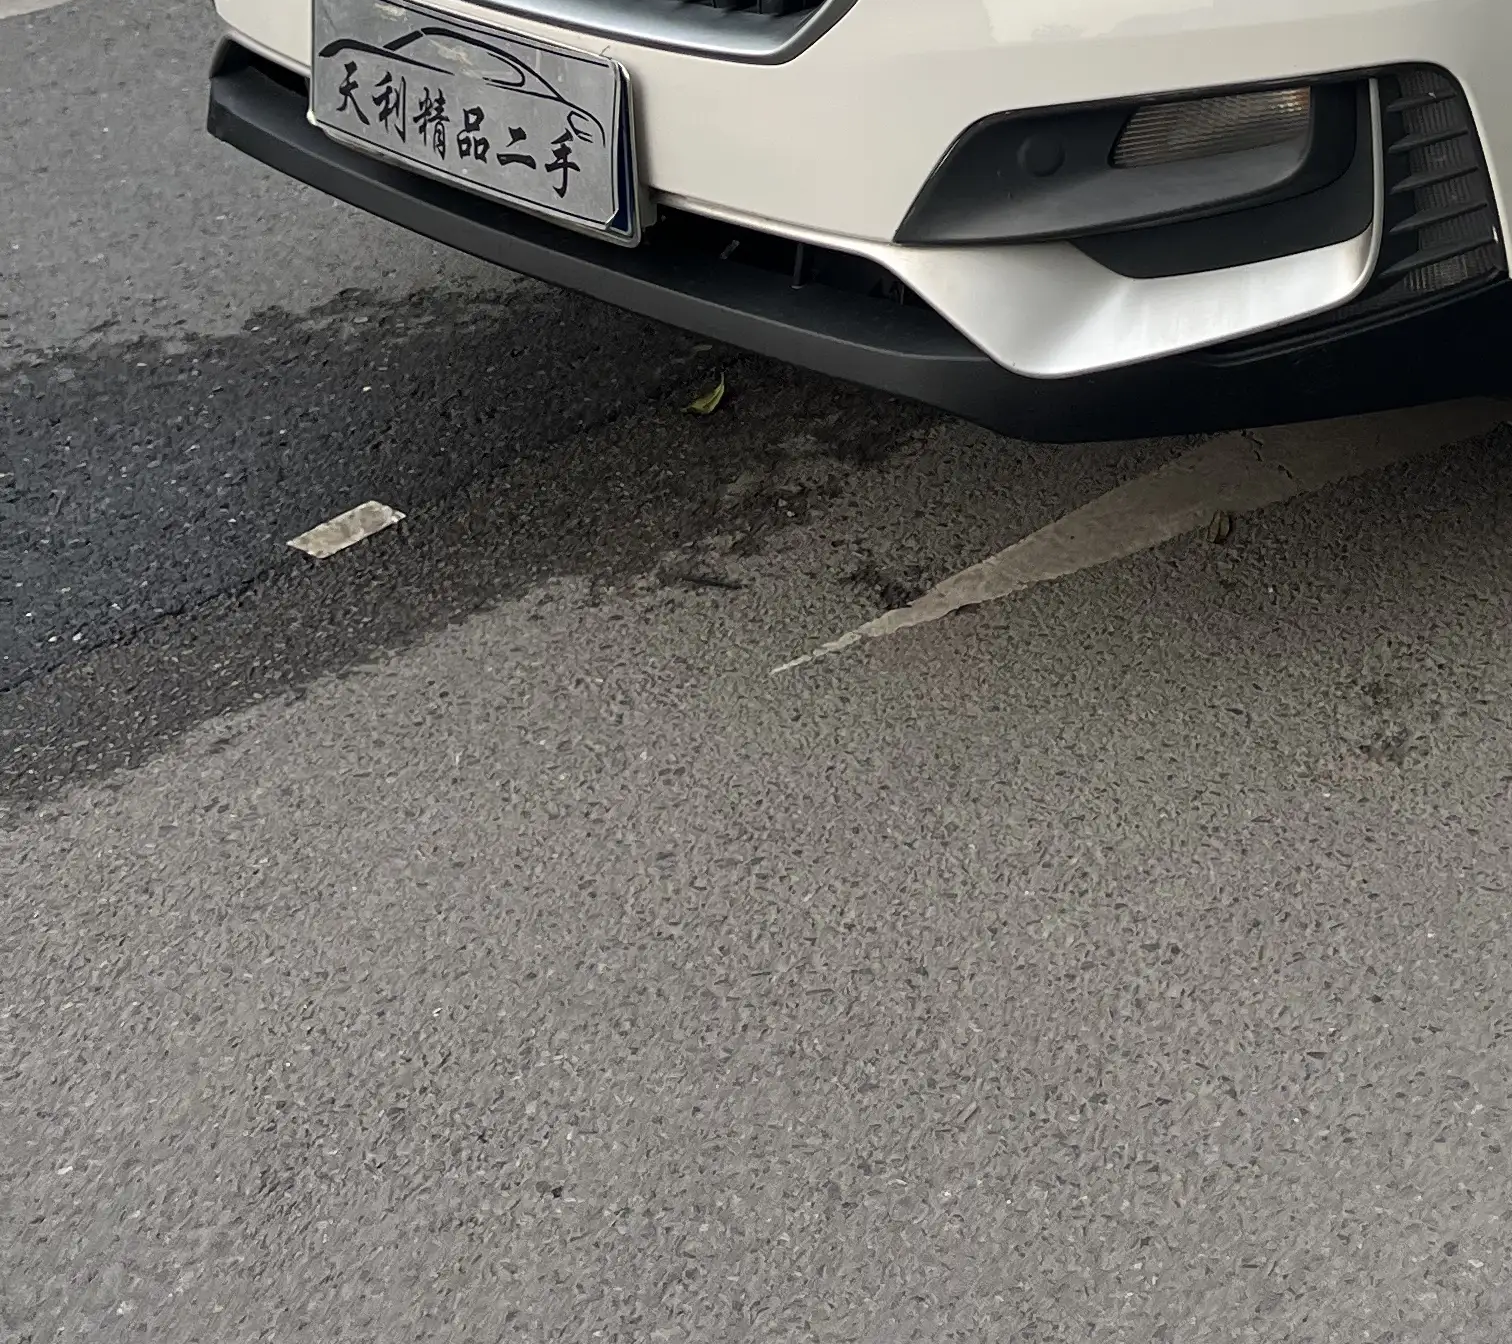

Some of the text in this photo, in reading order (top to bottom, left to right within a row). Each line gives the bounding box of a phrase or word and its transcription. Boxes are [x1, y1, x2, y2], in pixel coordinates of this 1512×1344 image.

[336, 61, 581, 199] 天利精品二手
